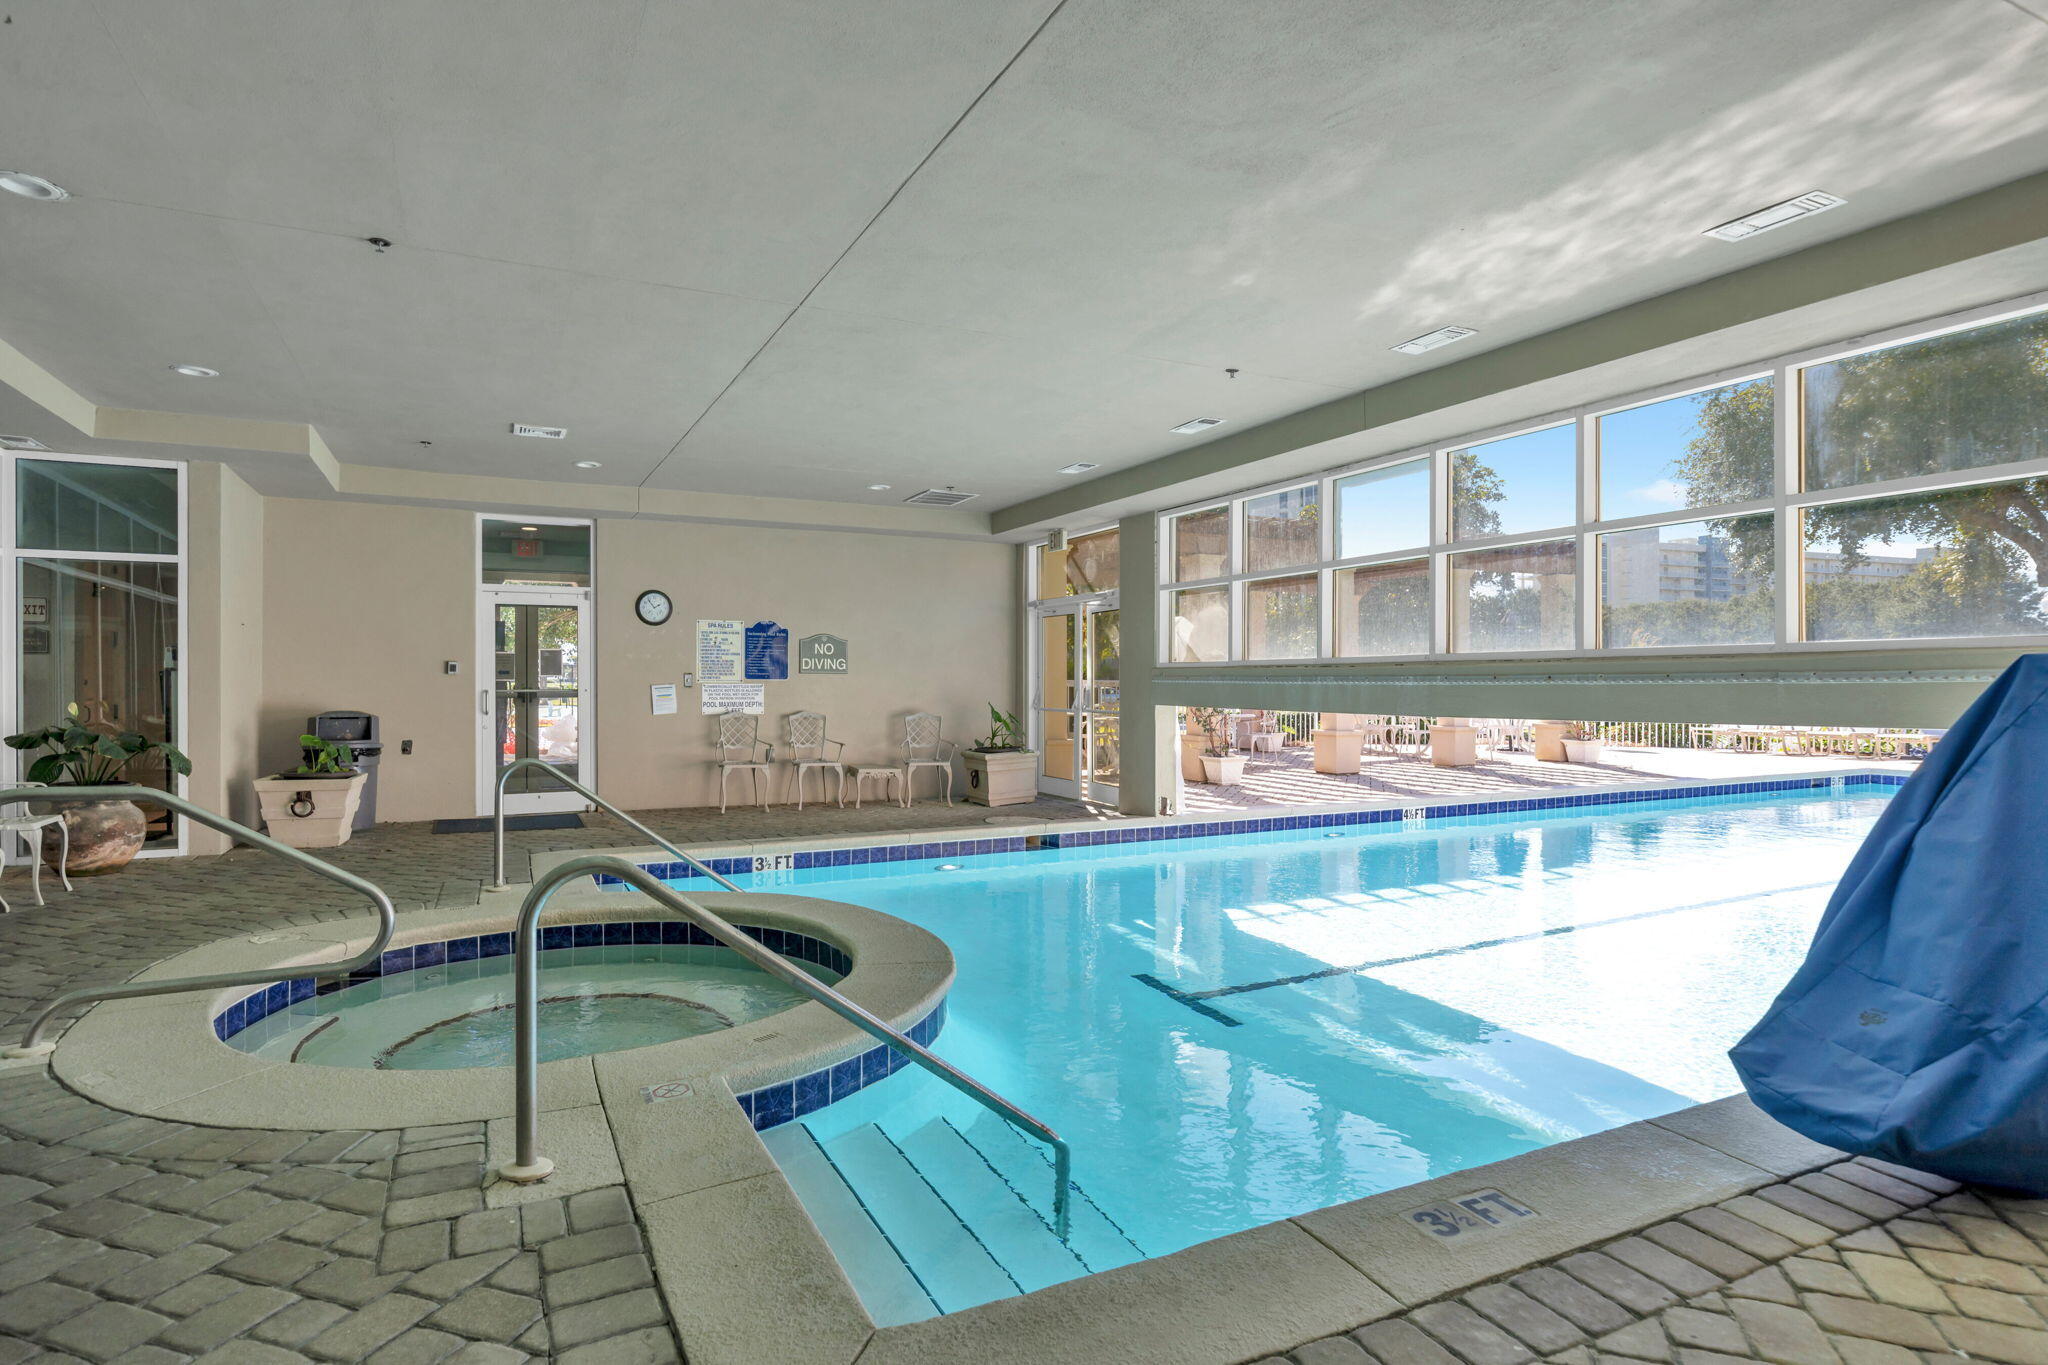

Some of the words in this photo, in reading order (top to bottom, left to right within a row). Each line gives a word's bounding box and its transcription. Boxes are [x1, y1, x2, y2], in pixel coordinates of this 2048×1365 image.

[23, 604, 46, 616] XIT
[814, 643, 834, 655] NO
[802, 658, 846, 670] DIVING
